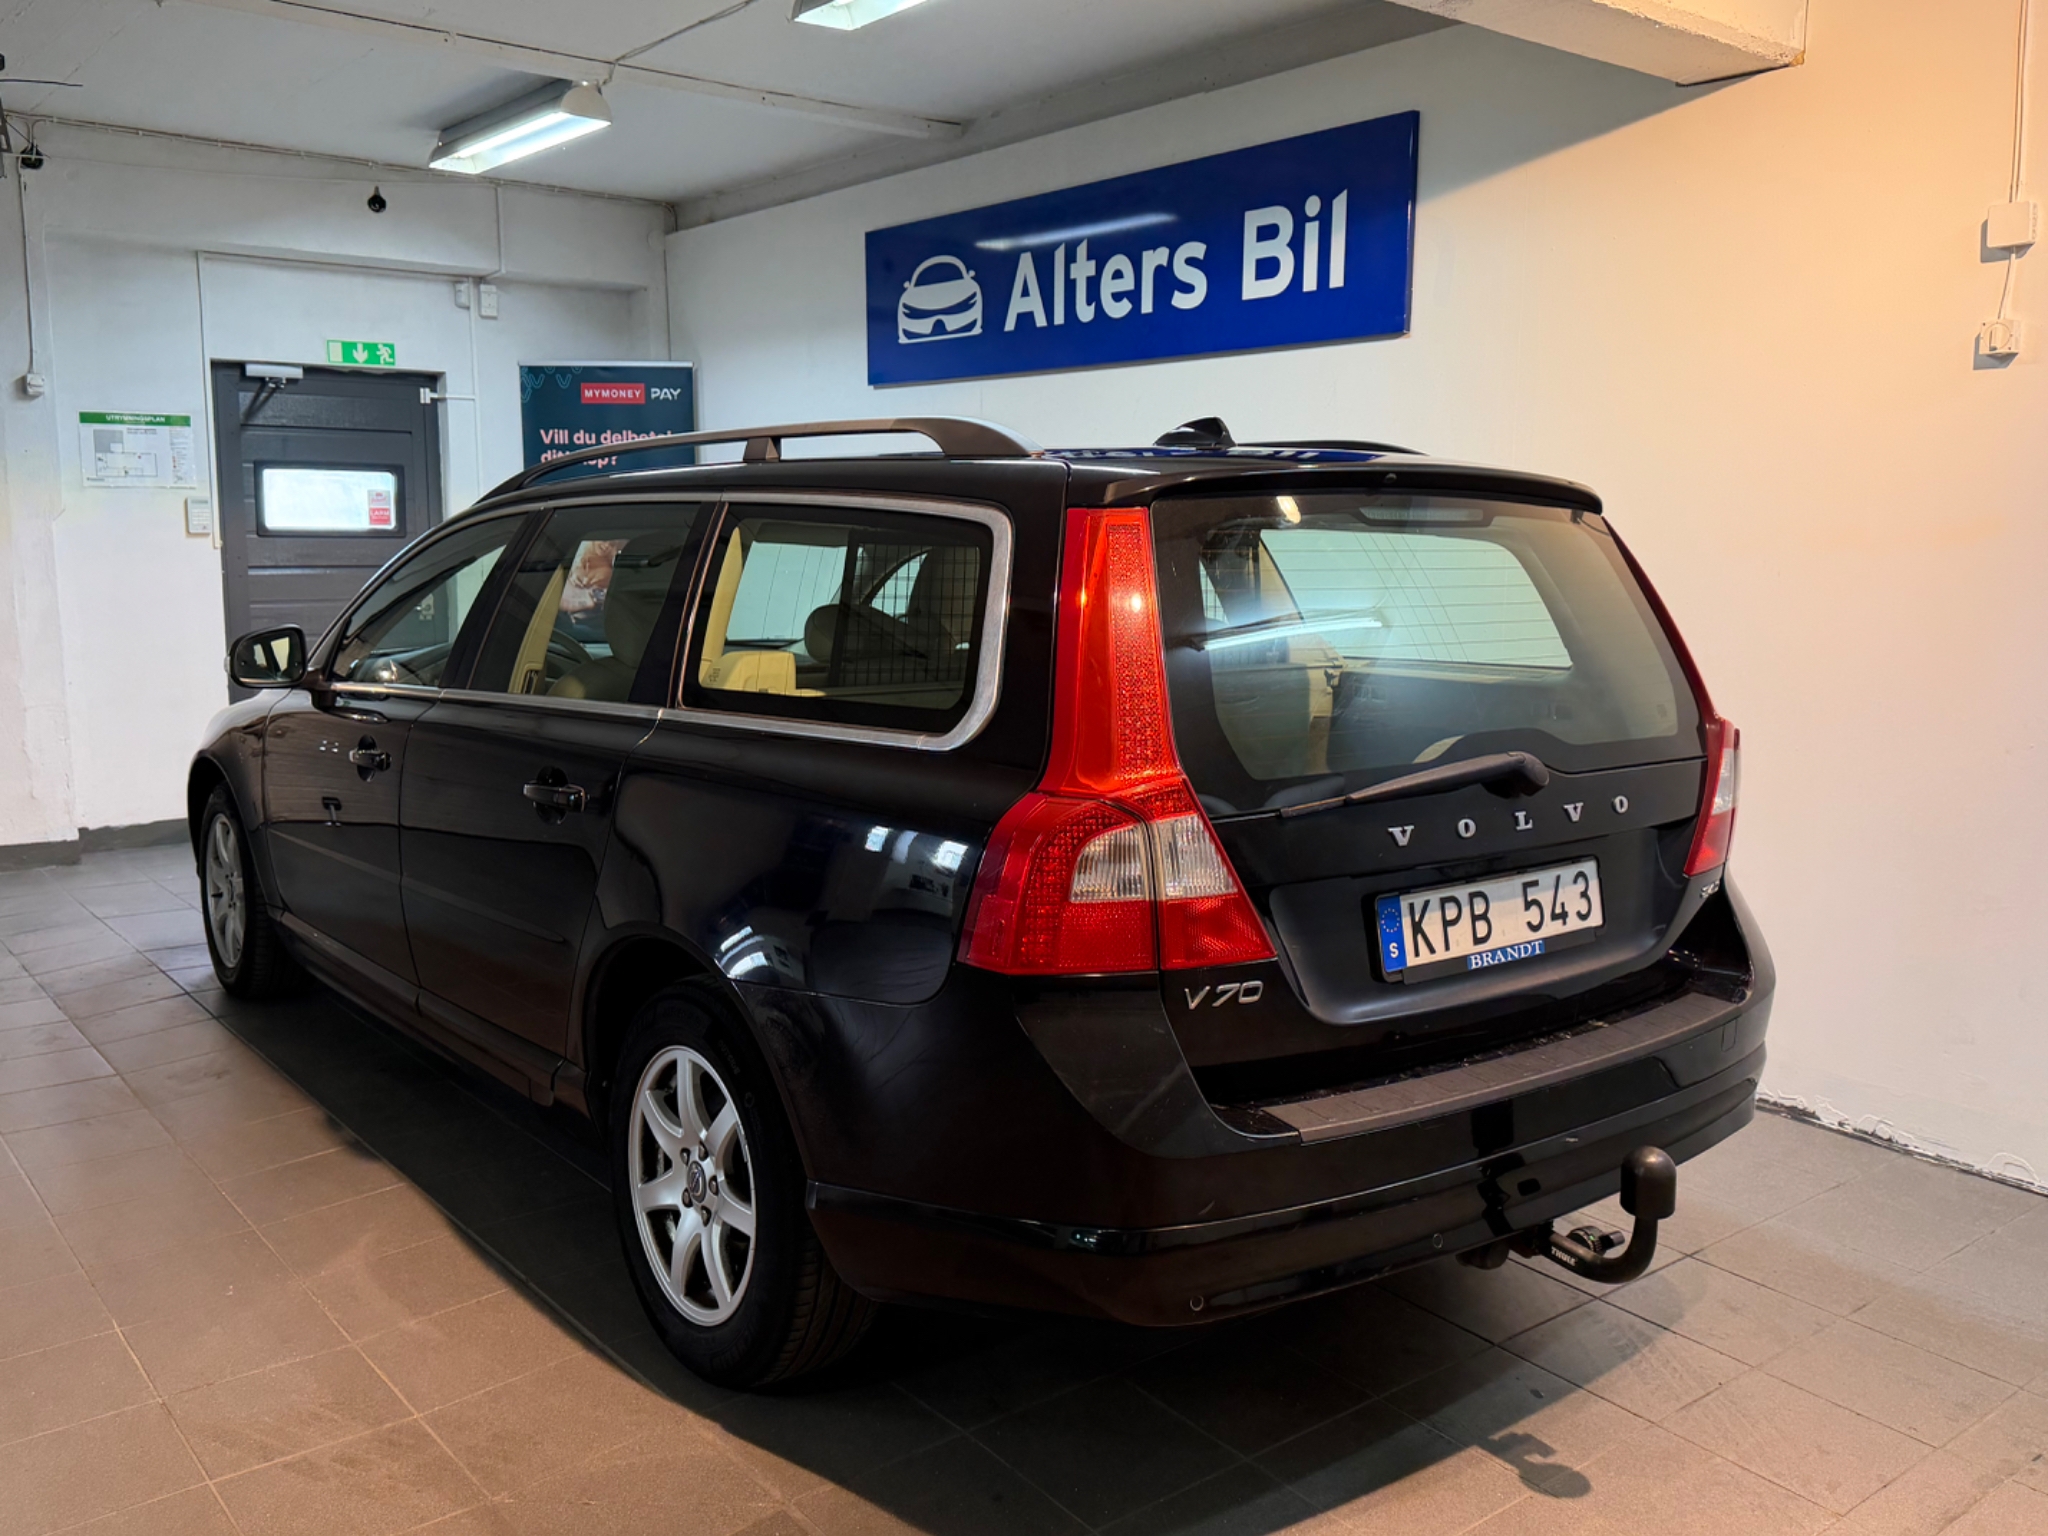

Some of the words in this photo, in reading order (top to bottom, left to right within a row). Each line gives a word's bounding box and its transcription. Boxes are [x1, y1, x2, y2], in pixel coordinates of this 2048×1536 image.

[1003, 238, 1208, 332] Alters
[1241, 188, 1348, 301] Bil
[584, 388, 642, 399] MYMONEY
[650, 387, 682, 400] PAY
[540, 429, 569, 444] Vill
[573, 430, 596, 445] du
[1387, 795, 1629, 846] VOLVO
[1408, 889, 1493, 958] KPB
[1521, 870, 1593, 933] 543
[1389, 942, 1399, 958] S
[1470, 941, 1544, 969] BRANDT
[1184, 980, 1264, 1010] V70
[1551, 1246, 1577, 1266] THULE
